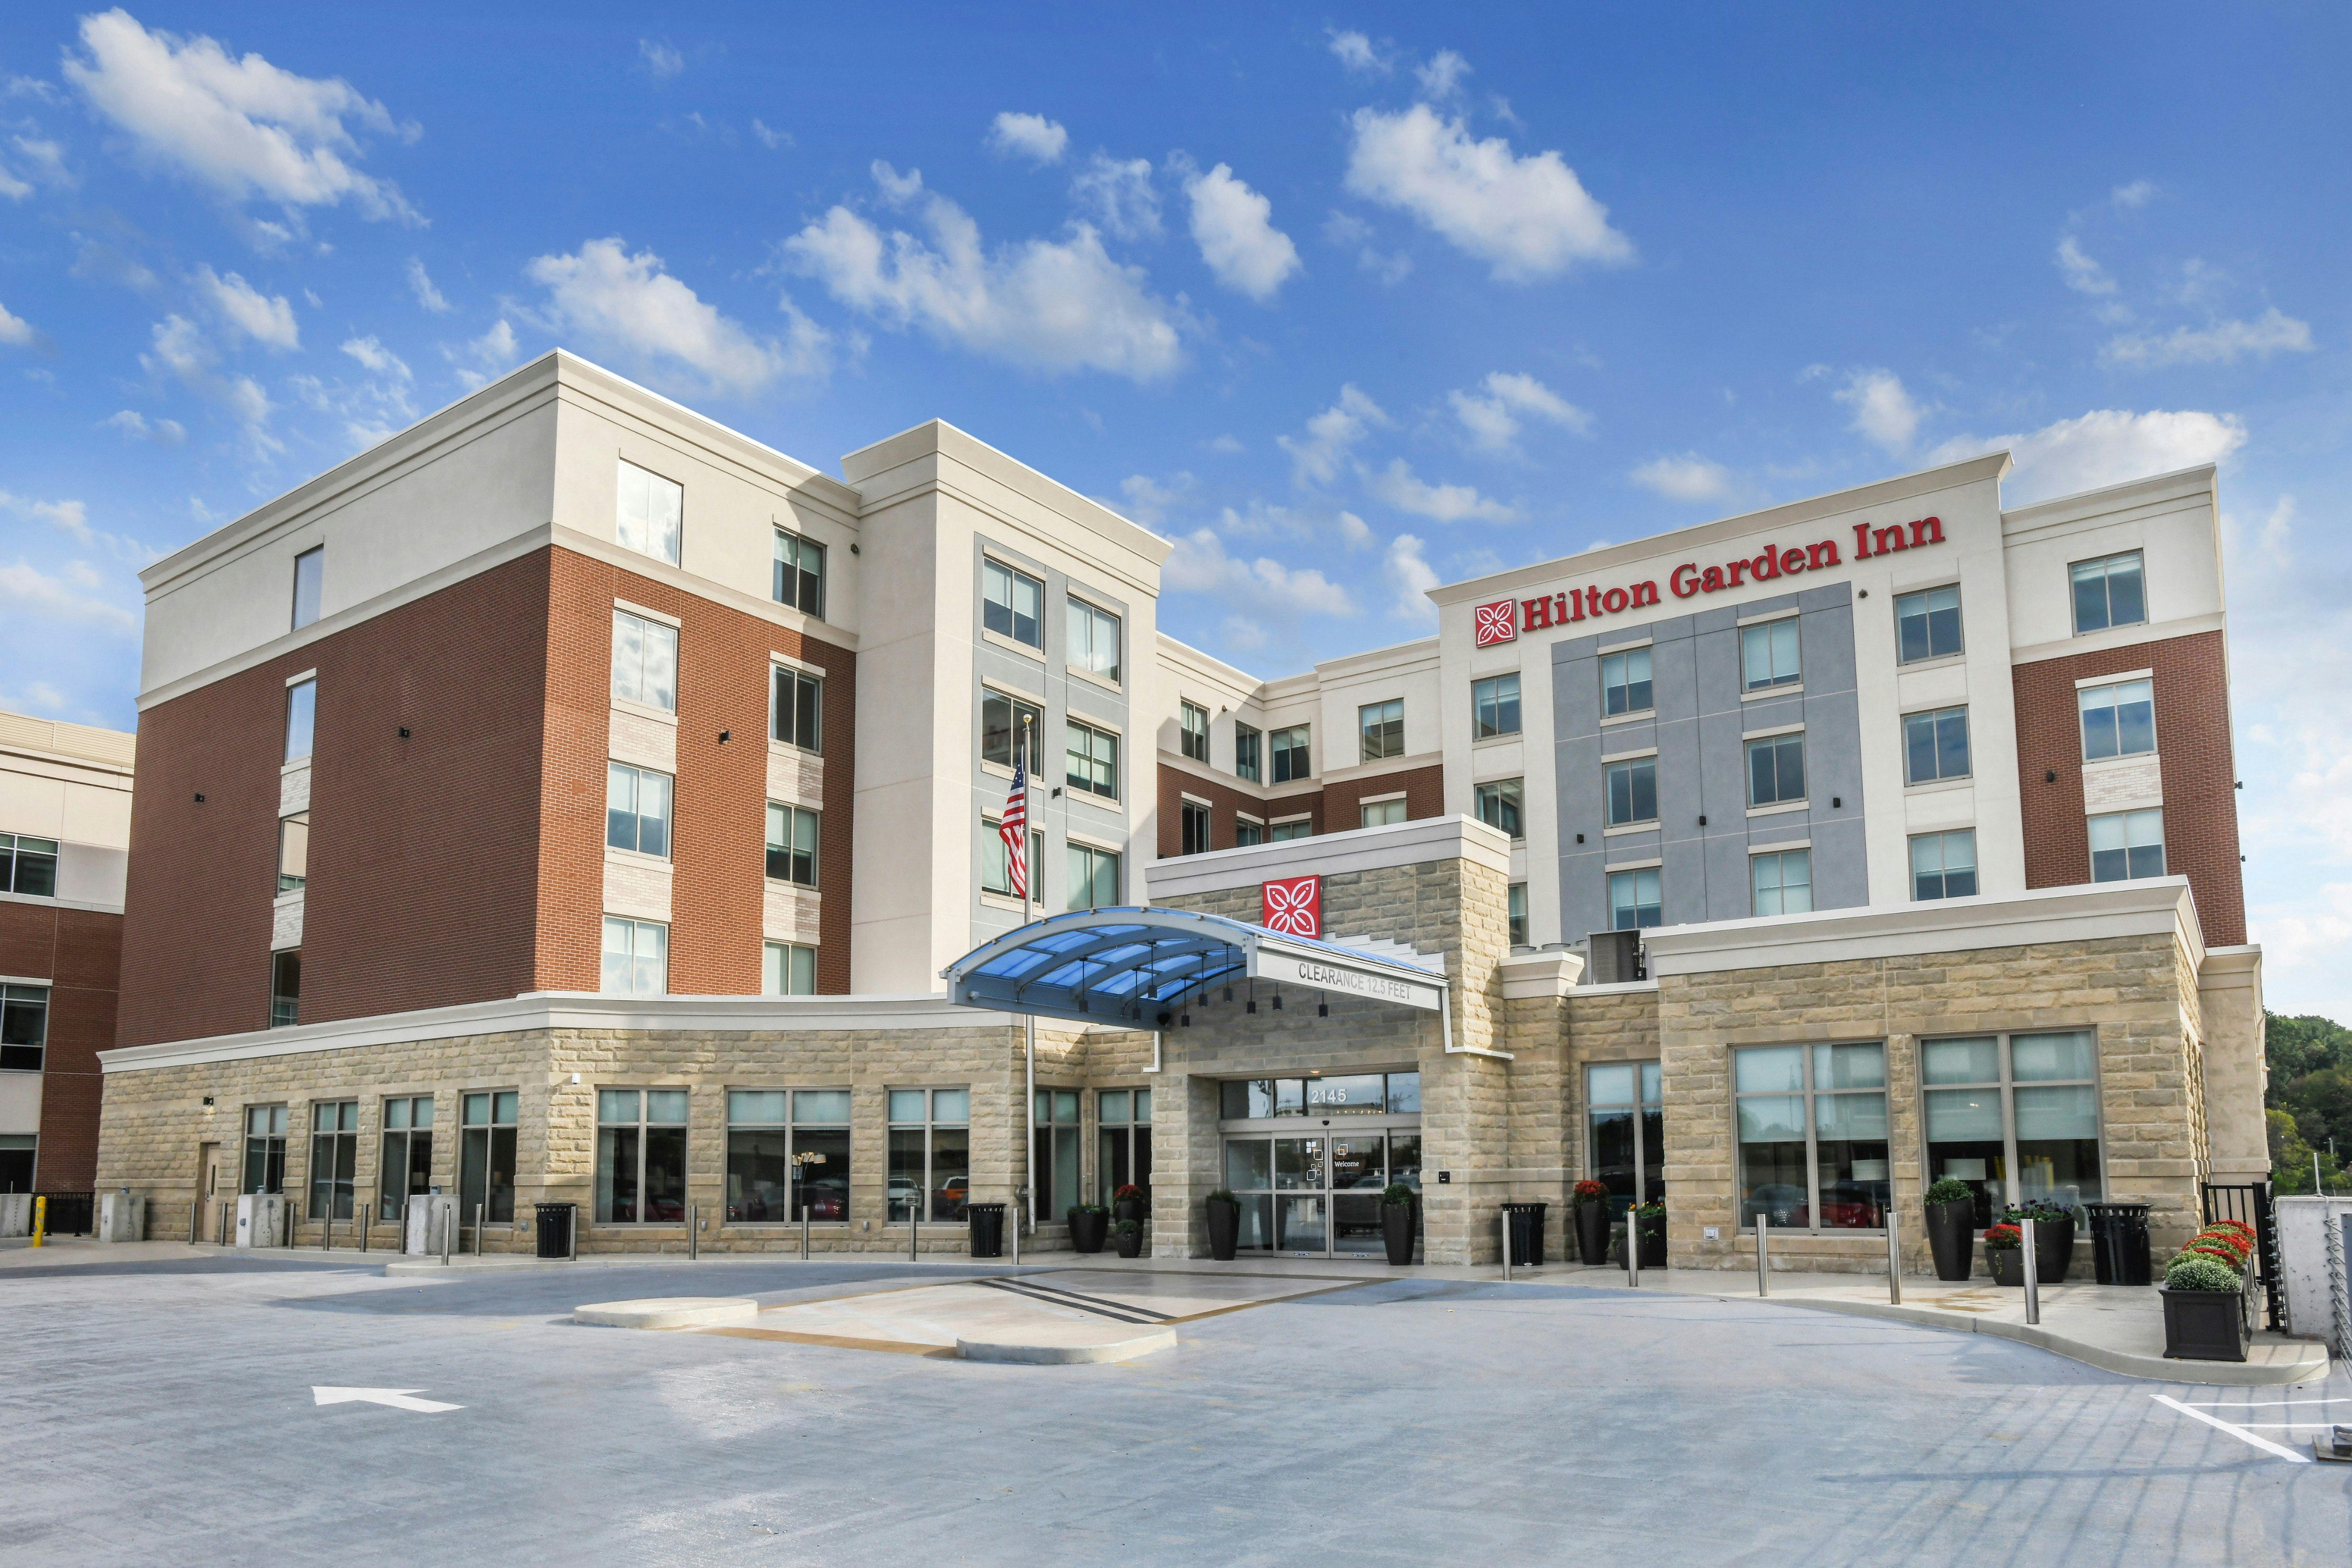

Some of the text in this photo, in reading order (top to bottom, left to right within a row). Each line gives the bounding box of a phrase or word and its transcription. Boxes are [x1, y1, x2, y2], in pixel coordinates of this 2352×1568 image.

[1521, 516, 1946, 631] Hilton Garden Inn
[1299, 962, 1411, 999] CLEARANCE 12.5 FEET
[1311, 1089, 1347, 1103] 2145
